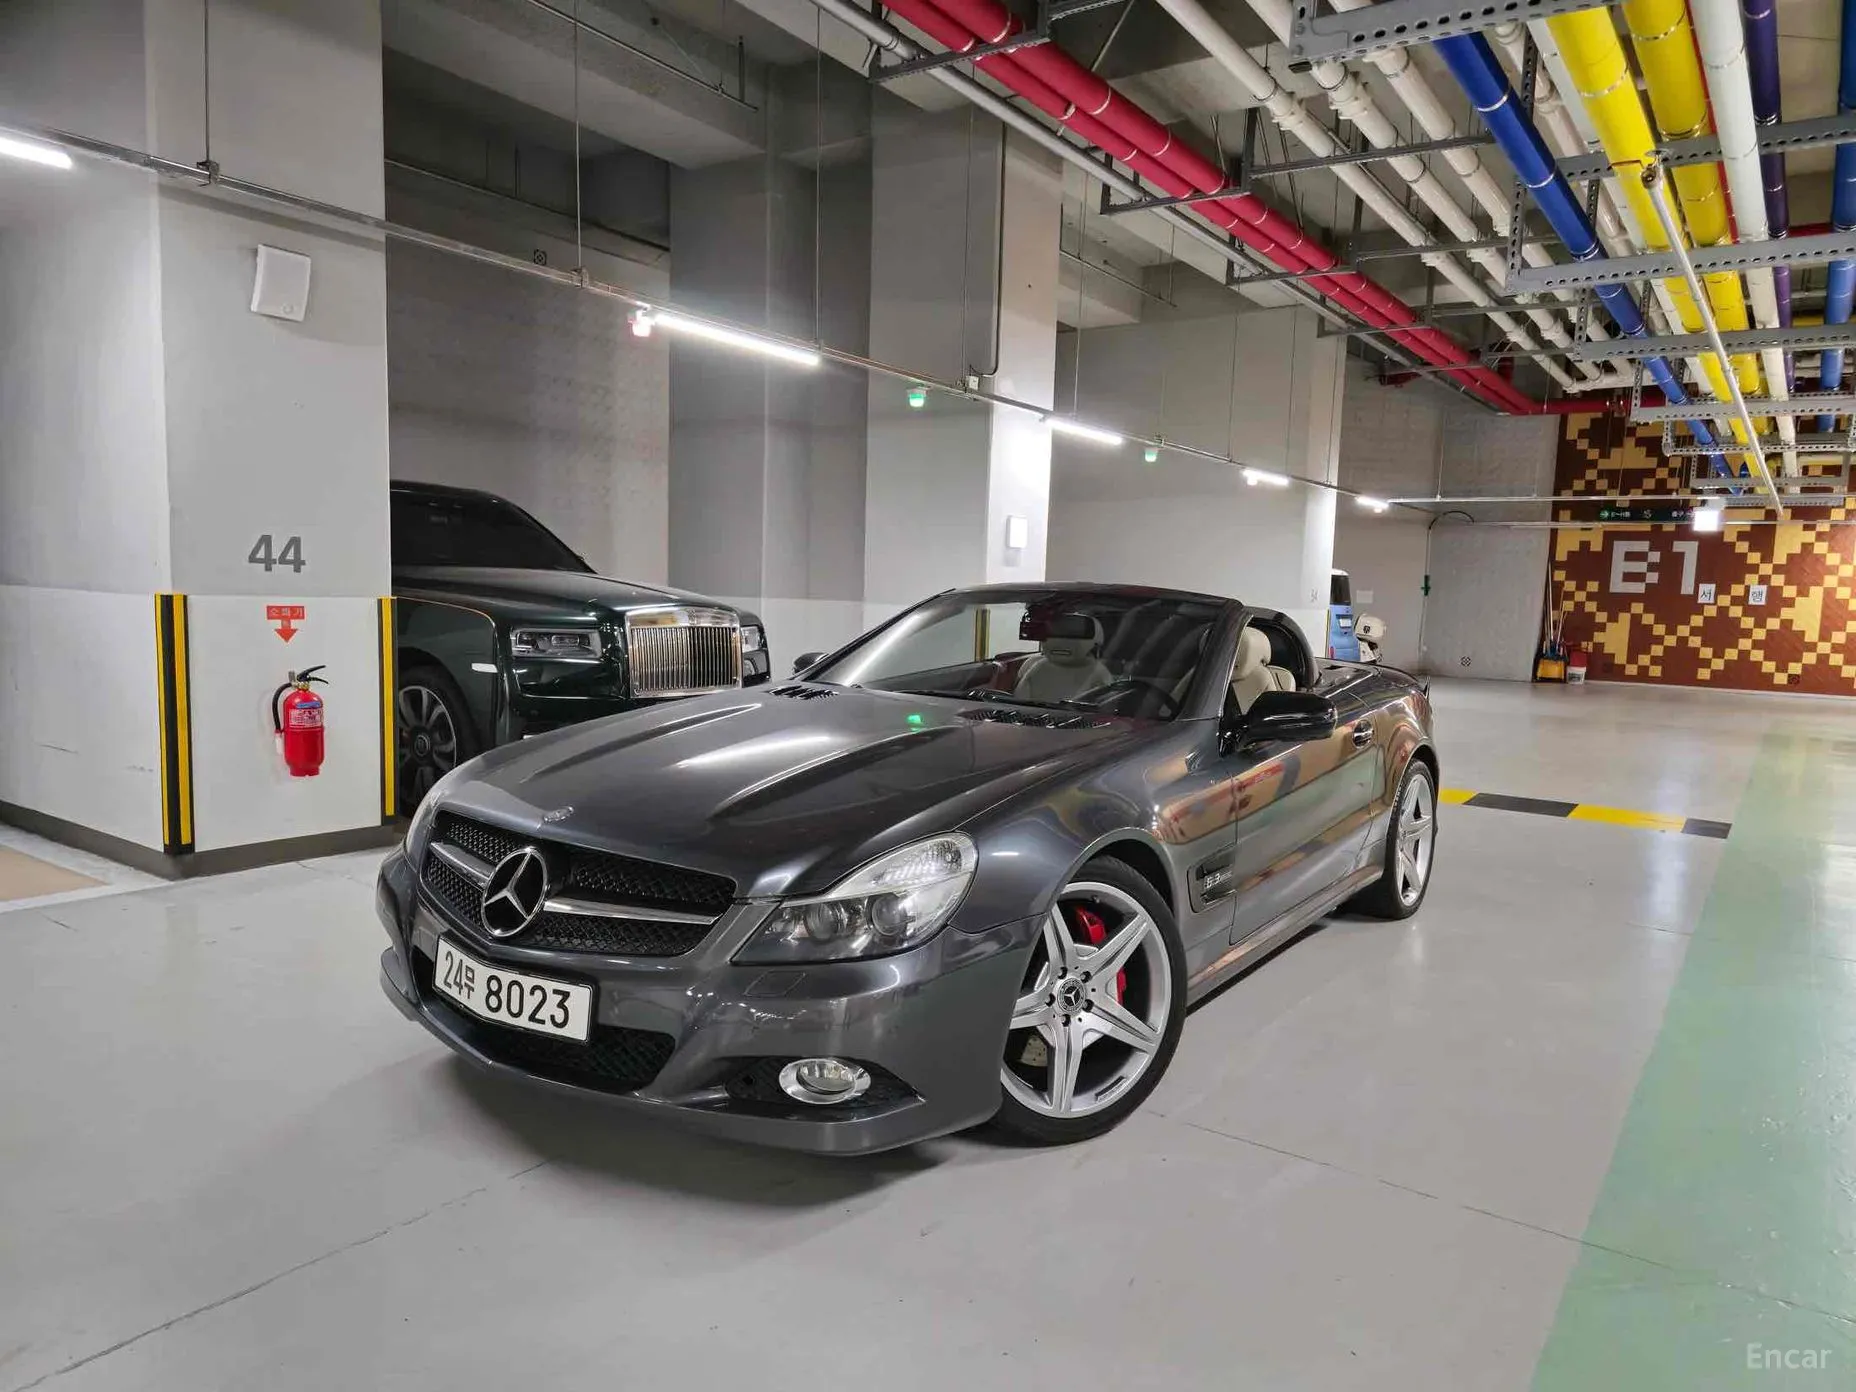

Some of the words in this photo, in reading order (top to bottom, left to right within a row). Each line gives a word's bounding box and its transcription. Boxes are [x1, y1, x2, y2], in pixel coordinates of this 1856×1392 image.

[248, 534, 306, 573] 44
[1609, 540, 1698, 594] B1
[443, 951, 475, 999] 24무
[485, 974, 571, 1029] 8023
